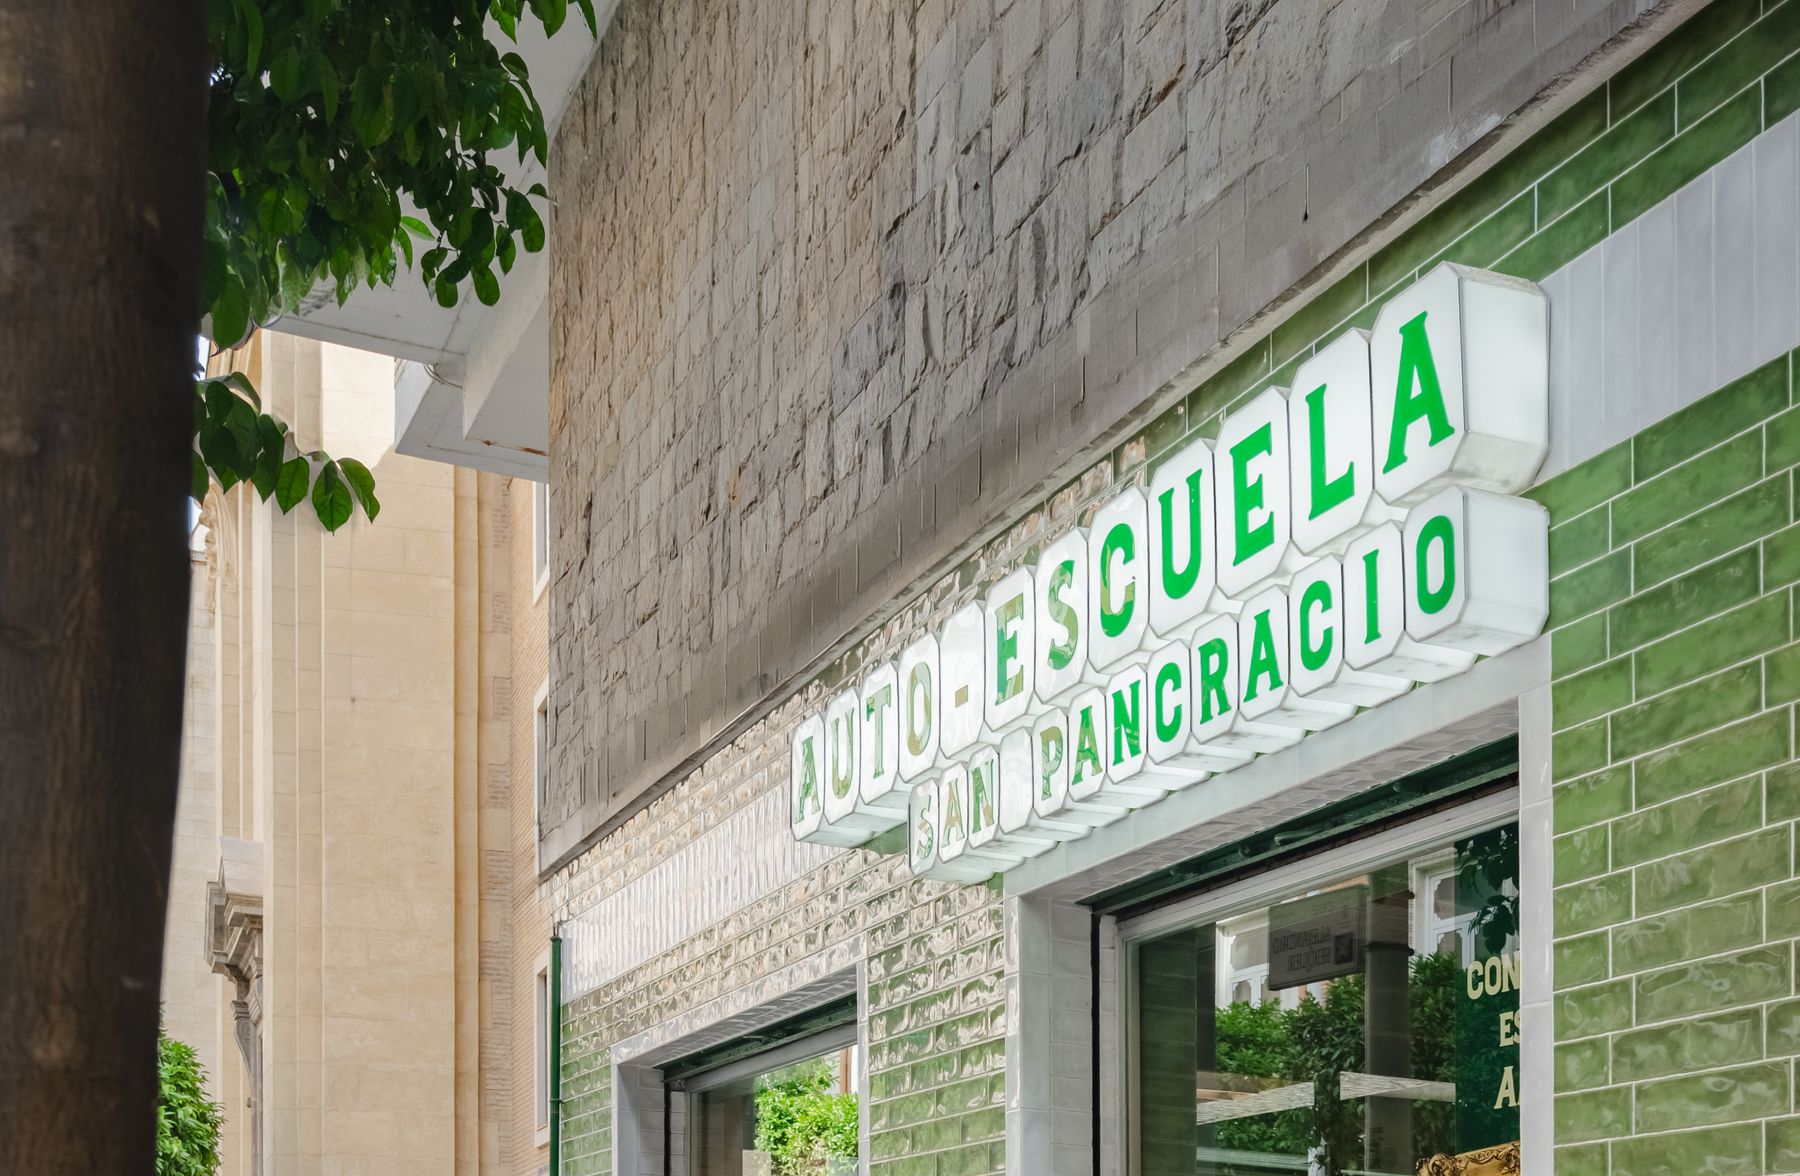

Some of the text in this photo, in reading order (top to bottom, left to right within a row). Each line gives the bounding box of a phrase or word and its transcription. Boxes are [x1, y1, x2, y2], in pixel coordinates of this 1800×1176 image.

[795, 311, 1455, 822] AUTO-ESCUELA
[915, 515, 1455, 860] SAN PANCRACIO
[1493, 1065, 1520, 1110] A
